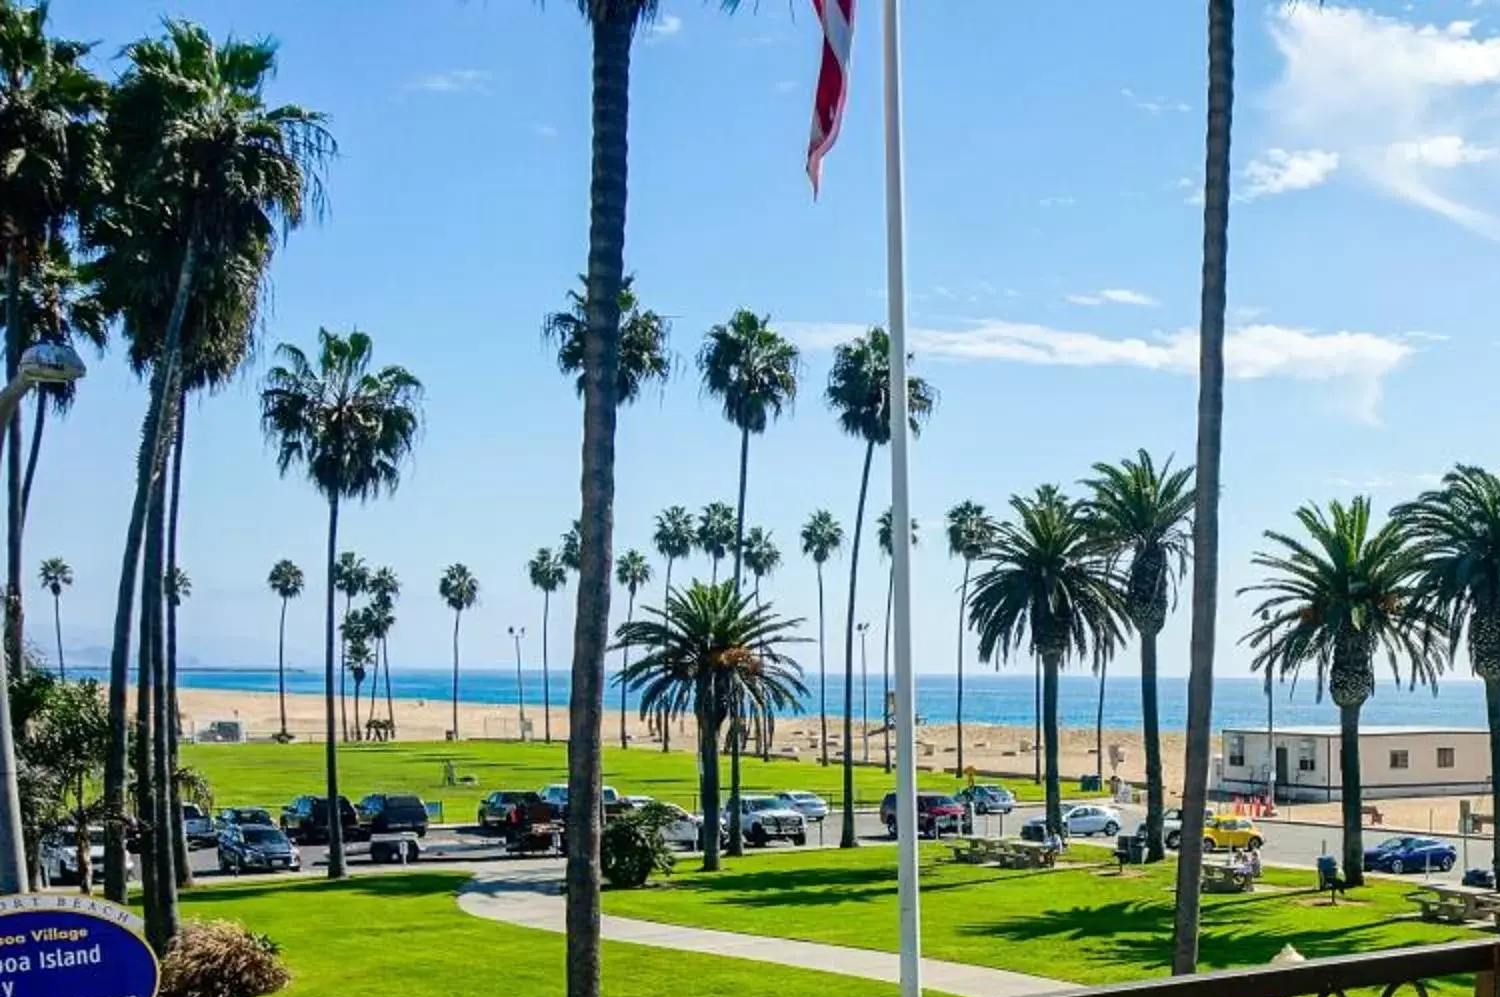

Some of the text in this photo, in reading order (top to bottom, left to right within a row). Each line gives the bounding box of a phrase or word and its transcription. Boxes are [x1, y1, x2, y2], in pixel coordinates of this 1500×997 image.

[57, 897, 129, 922] BEACH
[30, 927, 89, 942] Village
[39, 943, 101, 969] Island
